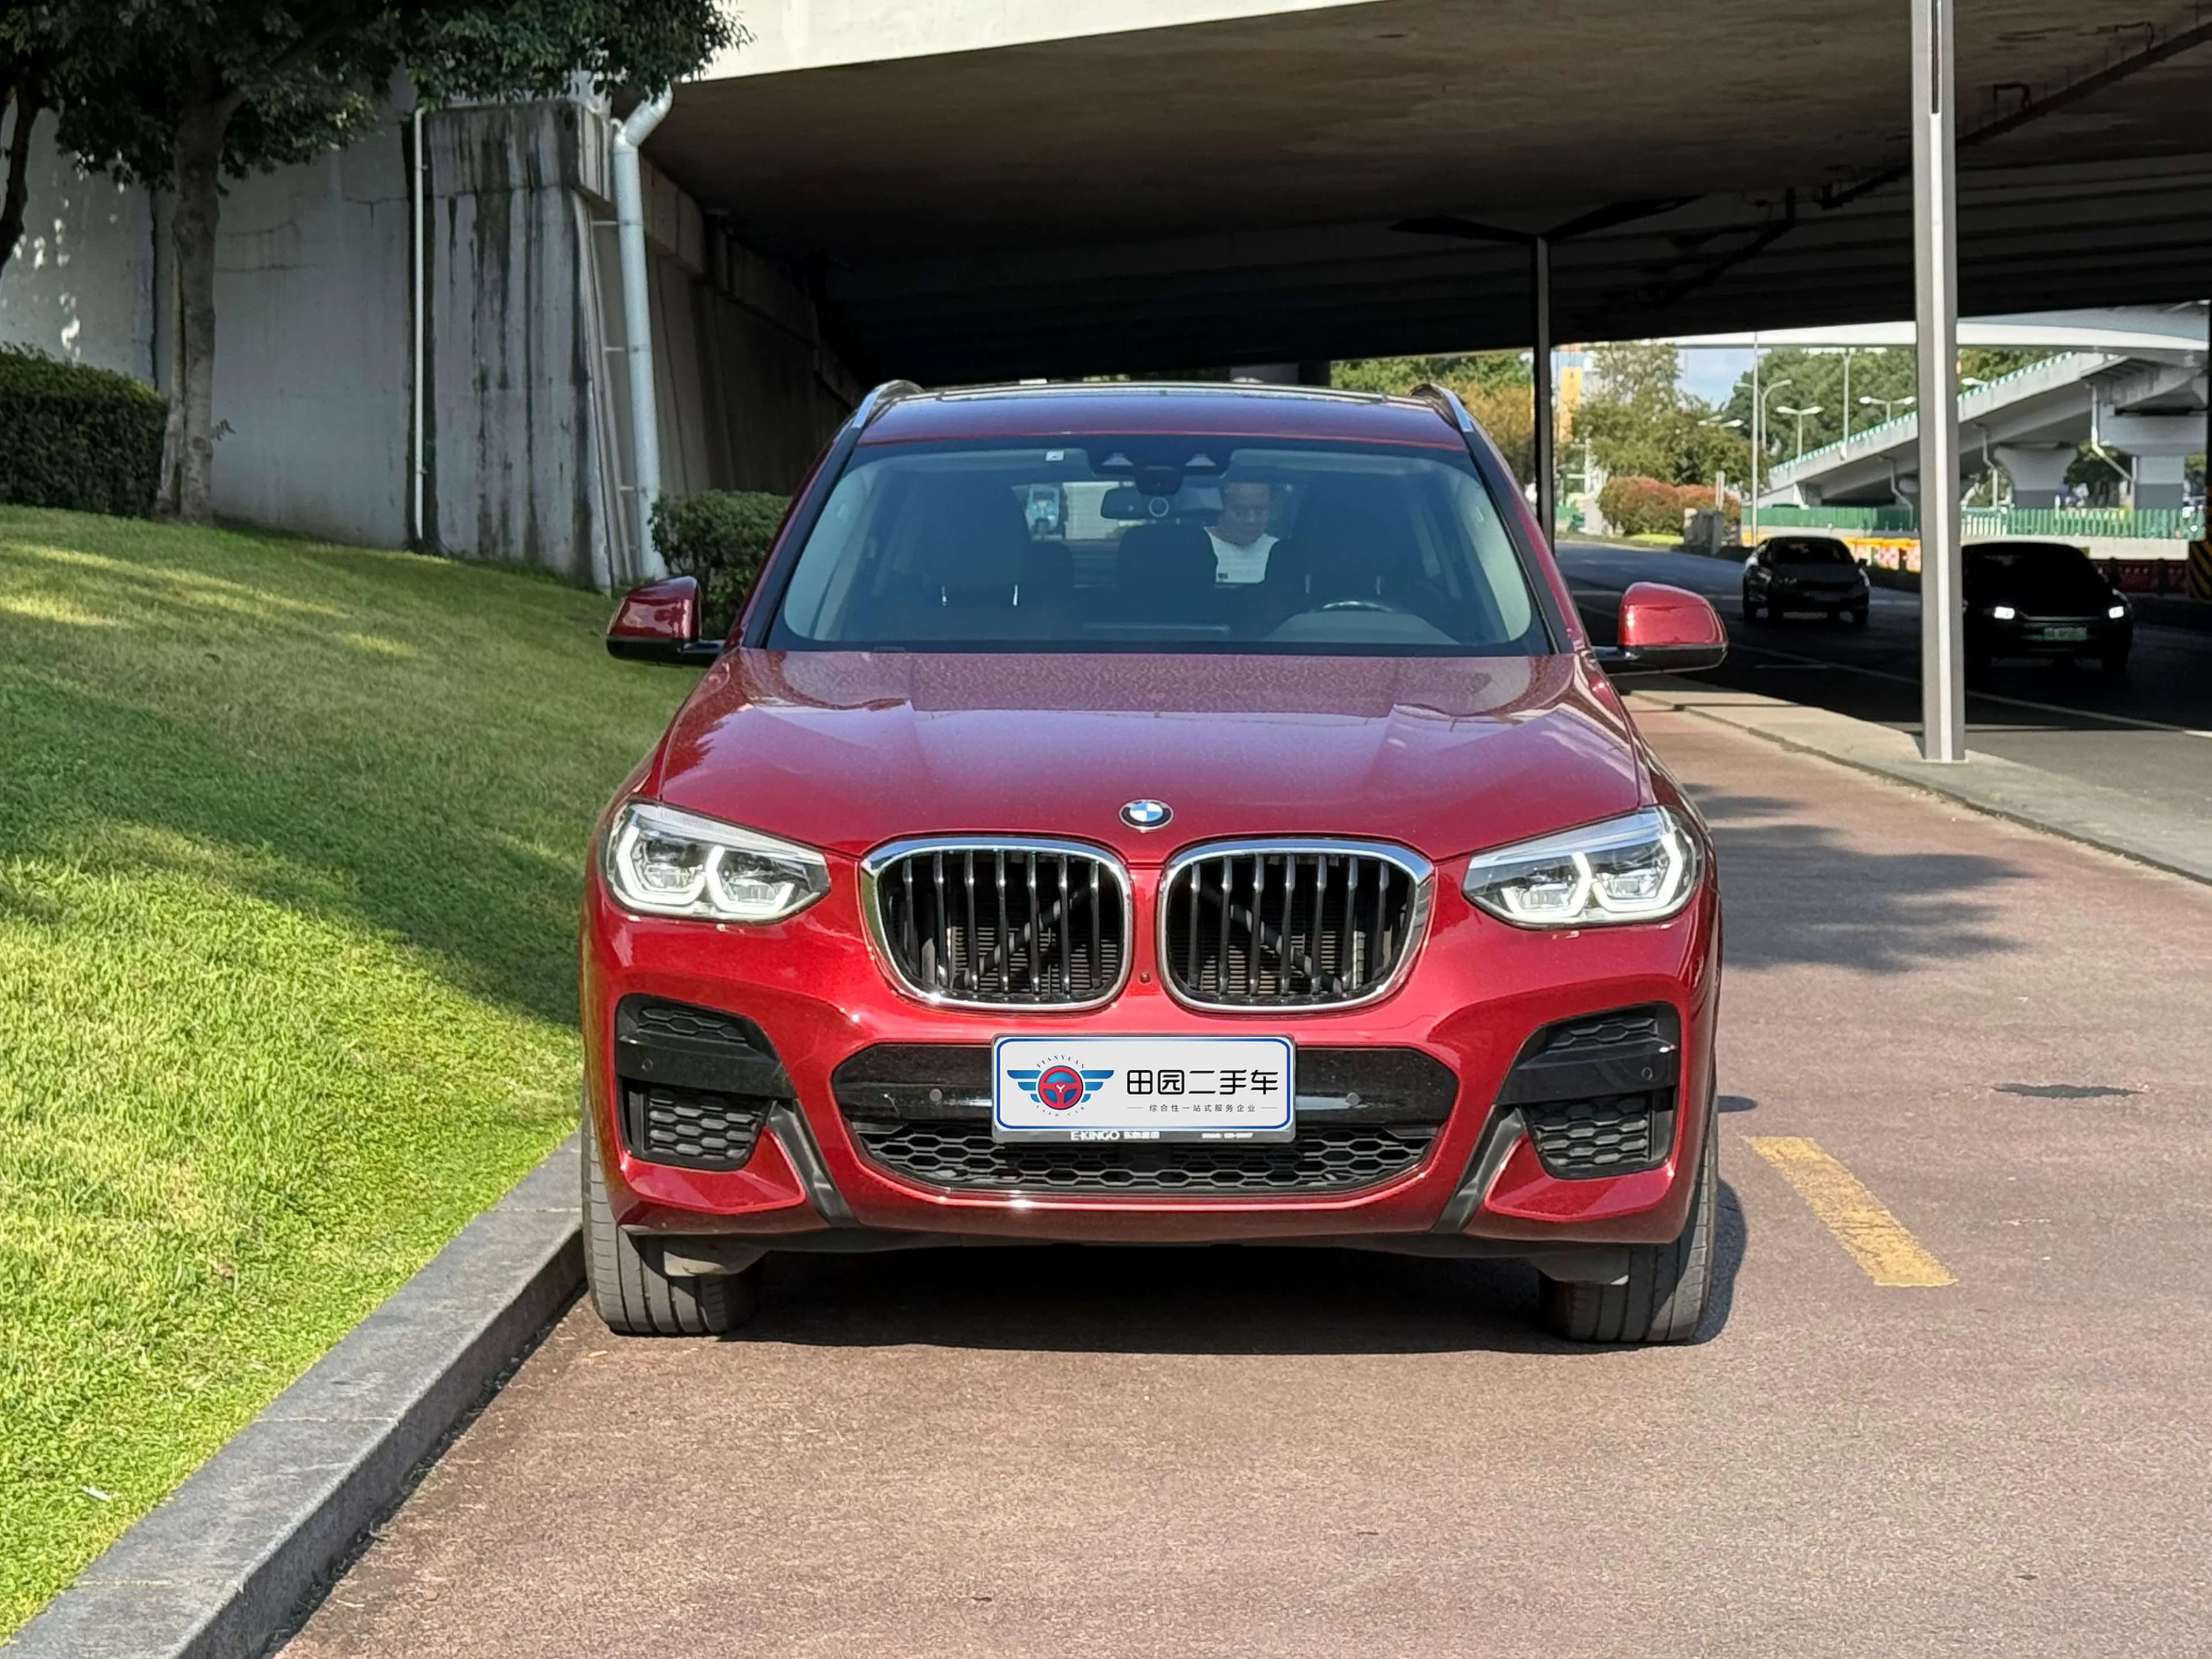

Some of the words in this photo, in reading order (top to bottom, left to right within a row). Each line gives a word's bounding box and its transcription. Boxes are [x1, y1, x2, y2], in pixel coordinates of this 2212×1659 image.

[1127, 1069, 1278, 1095] 田园二手车
[1149, 1104, 1256, 1112] 综合性一站式服务企业
